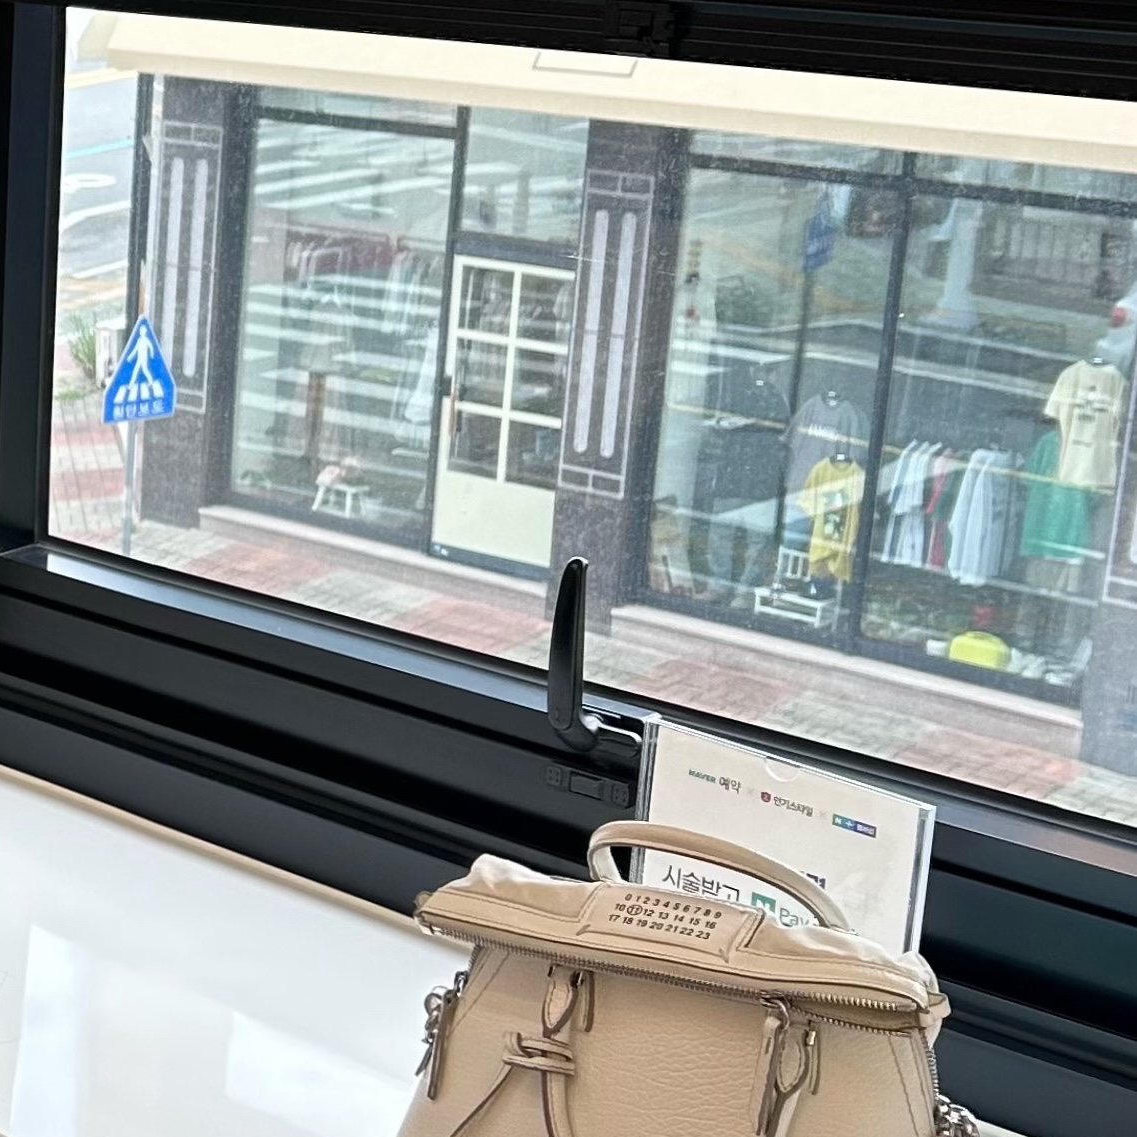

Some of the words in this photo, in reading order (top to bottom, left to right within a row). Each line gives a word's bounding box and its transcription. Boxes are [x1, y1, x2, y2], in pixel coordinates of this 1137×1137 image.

[719, 776, 742, 794] 예약
[614, 903, 627, 912] 10
[643, 908, 655, 917] 12
[658, 911, 669, 920] 13
[673, 914, 685, 922] 14
[689, 917, 702, 926] 15
[704, 920, 717, 929] 16
[624, 893, 633, 901] 0
[643, 896, 651, 904] 2
[652, 898, 661, 907] 3
[662, 900, 671, 908] 4
[672, 902, 681, 911] 5
[682, 904, 691, 913] 6
[693, 906, 702, 914] 7
[703, 908, 712, 917] 8
[713, 911, 722, 919] 9
[608, 914, 621, 922] 17
[622, 916, 634, 925] 18
[635, 919, 648, 927] 19
[649, 921, 664, 930] 20
[665, 924, 679, 933] 21
[679, 927, 694, 936] 22
[695, 930, 711, 940] 23
